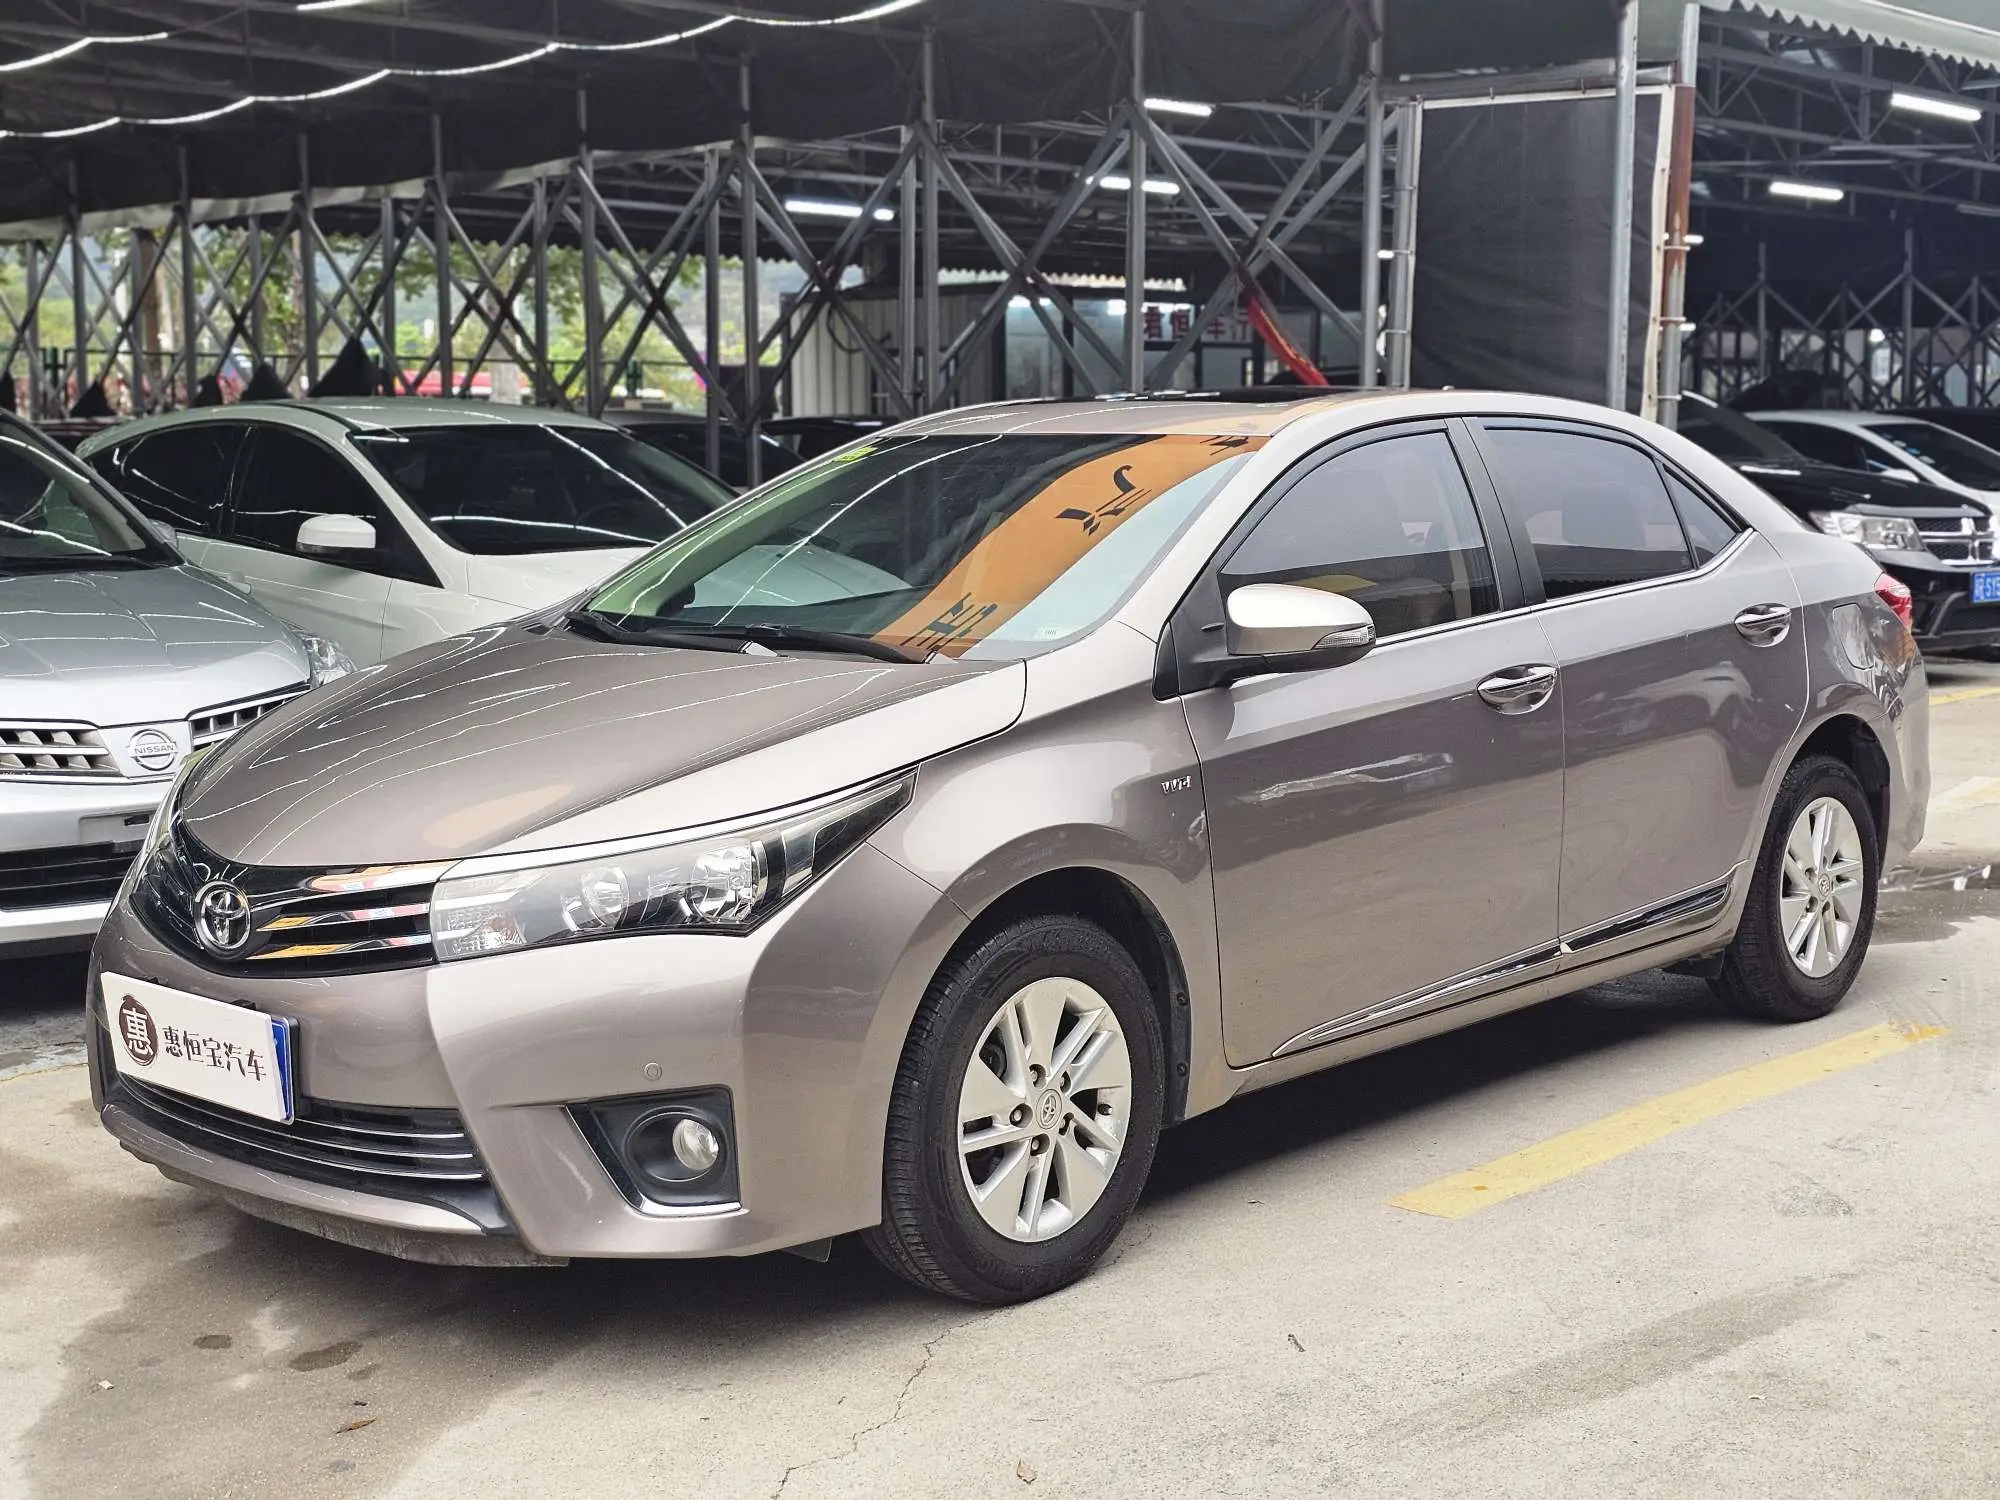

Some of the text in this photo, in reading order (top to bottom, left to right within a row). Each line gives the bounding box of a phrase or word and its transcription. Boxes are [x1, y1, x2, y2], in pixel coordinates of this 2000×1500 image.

[134, 744, 174, 754] NISSAN
[122, 1007, 154, 1056] 惠
[162, 1025, 267, 1082] 惠恒宝汽车
